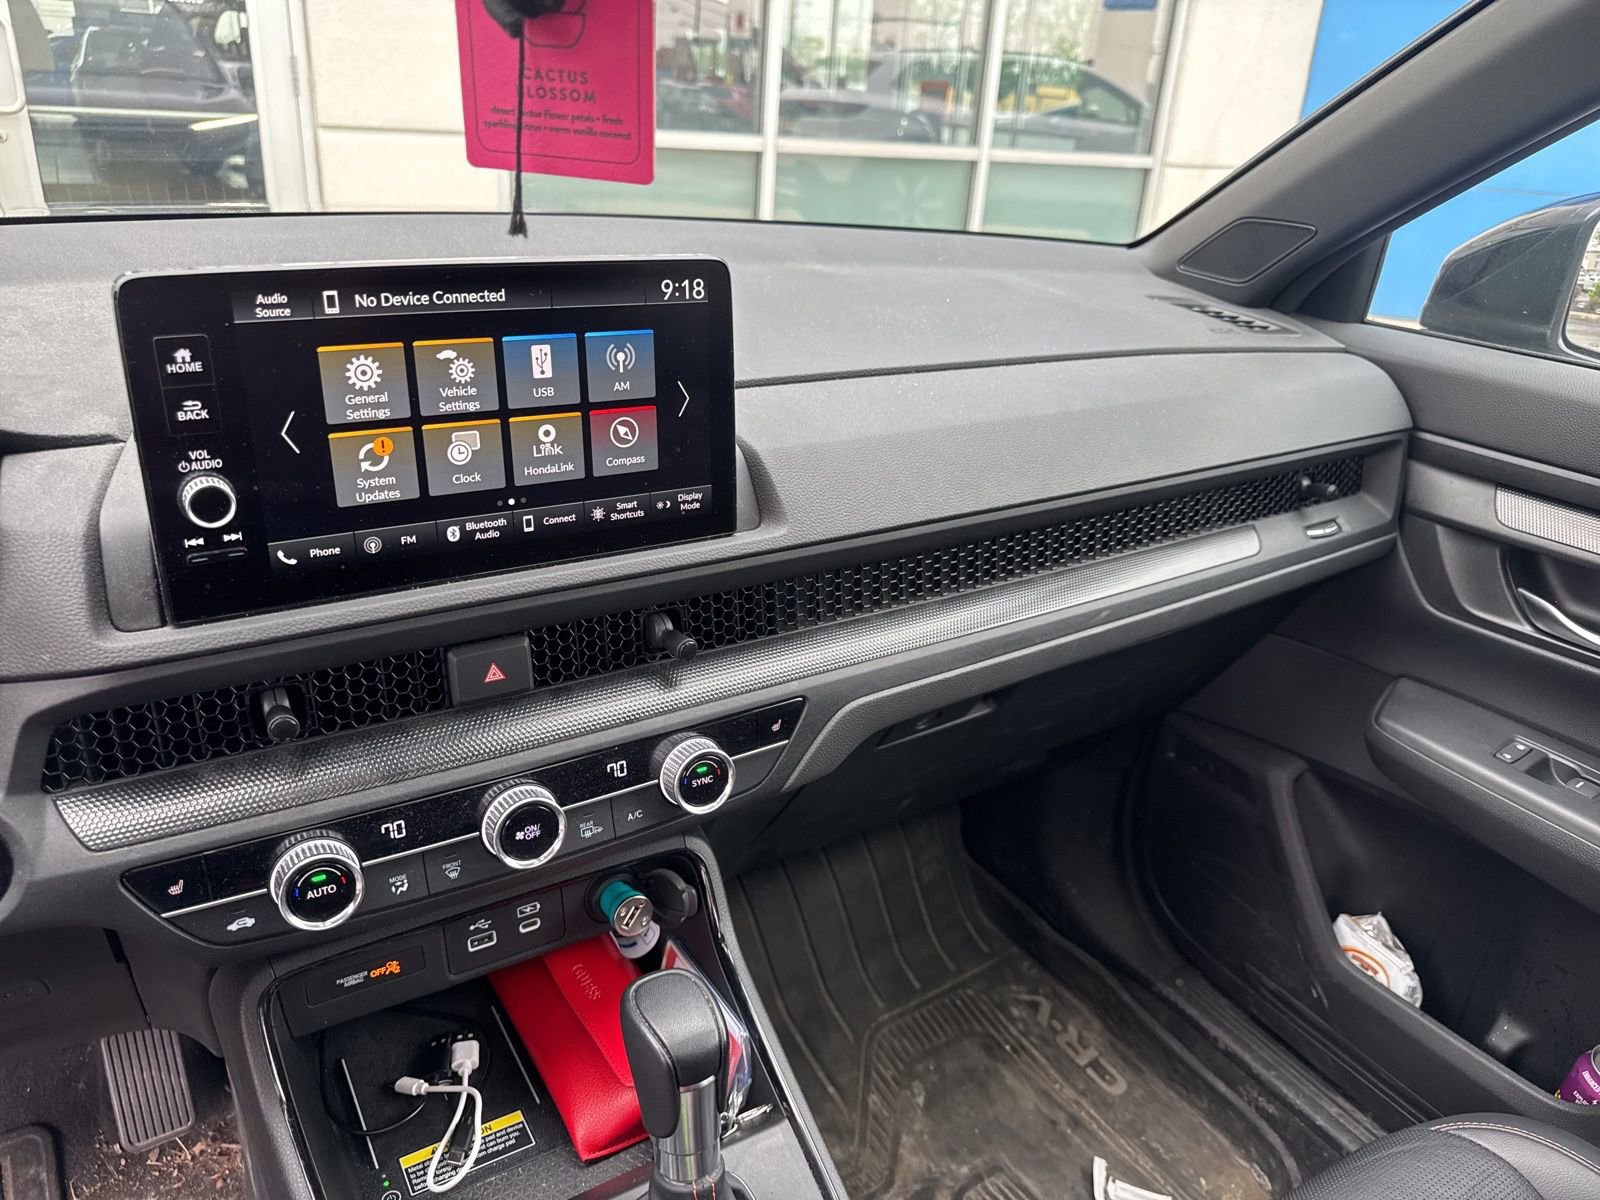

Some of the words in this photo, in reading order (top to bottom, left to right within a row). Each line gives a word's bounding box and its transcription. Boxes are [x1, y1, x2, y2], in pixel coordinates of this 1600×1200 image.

[527, 86, 596, 104] LOSSOM
[660, 278, 705, 300] 9:18
[256, 293, 288, 305] Audio
[355, 292, 378, 308] No
[381, 292, 429, 307] Device
[432, 289, 506, 305] Connected
[256, 306, 291, 318] Source
[166, 362, 204, 374] HOME
[439, 384, 478, 398] Vehicle
[533, 386, 555, 398] USB
[614, 381, 630, 392] AM
[345, 392, 389, 405] General
[439, 400, 480, 412] Settings
[177, 408, 210, 422] BACK
[346, 406, 391, 421] Settings
[188, 450, 211, 461] VOL
[606, 455, 646, 467] Compass
[191, 458, 222, 470] AUDIO
[524, 462, 574, 476] HondaLink
[356, 474, 396, 489] System
[452, 472, 482, 484] Clock
[356, 488, 400, 503] Updates
[678, 491, 703, 503] Display
[616, 500, 638, 510] Smart
[680, 500, 700, 510] Mode
[543, 512, 576, 526] Connect
[610, 510, 644, 522] Shortcuts
[466, 518, 507, 532] Bluetooth
[400, 534, 416, 546] FM
[474, 529, 500, 540] Audio
[310, 546, 341, 558] Phone
[606, 760, 628, 778] 70
[691, 775, 714, 788] SYNC
[627, 810, 643, 822] A/C
[380, 820, 406, 839] 70
[525, 824, 541, 833] ON/
[579, 820, 594, 829] REAR
[525, 832, 541, 840] OFF
[442, 860, 461, 870] FRONT
[389, 874, 407, 883] MODE
[306, 884, 337, 900] AUTO
[370, 966, 386, 978] OFF
